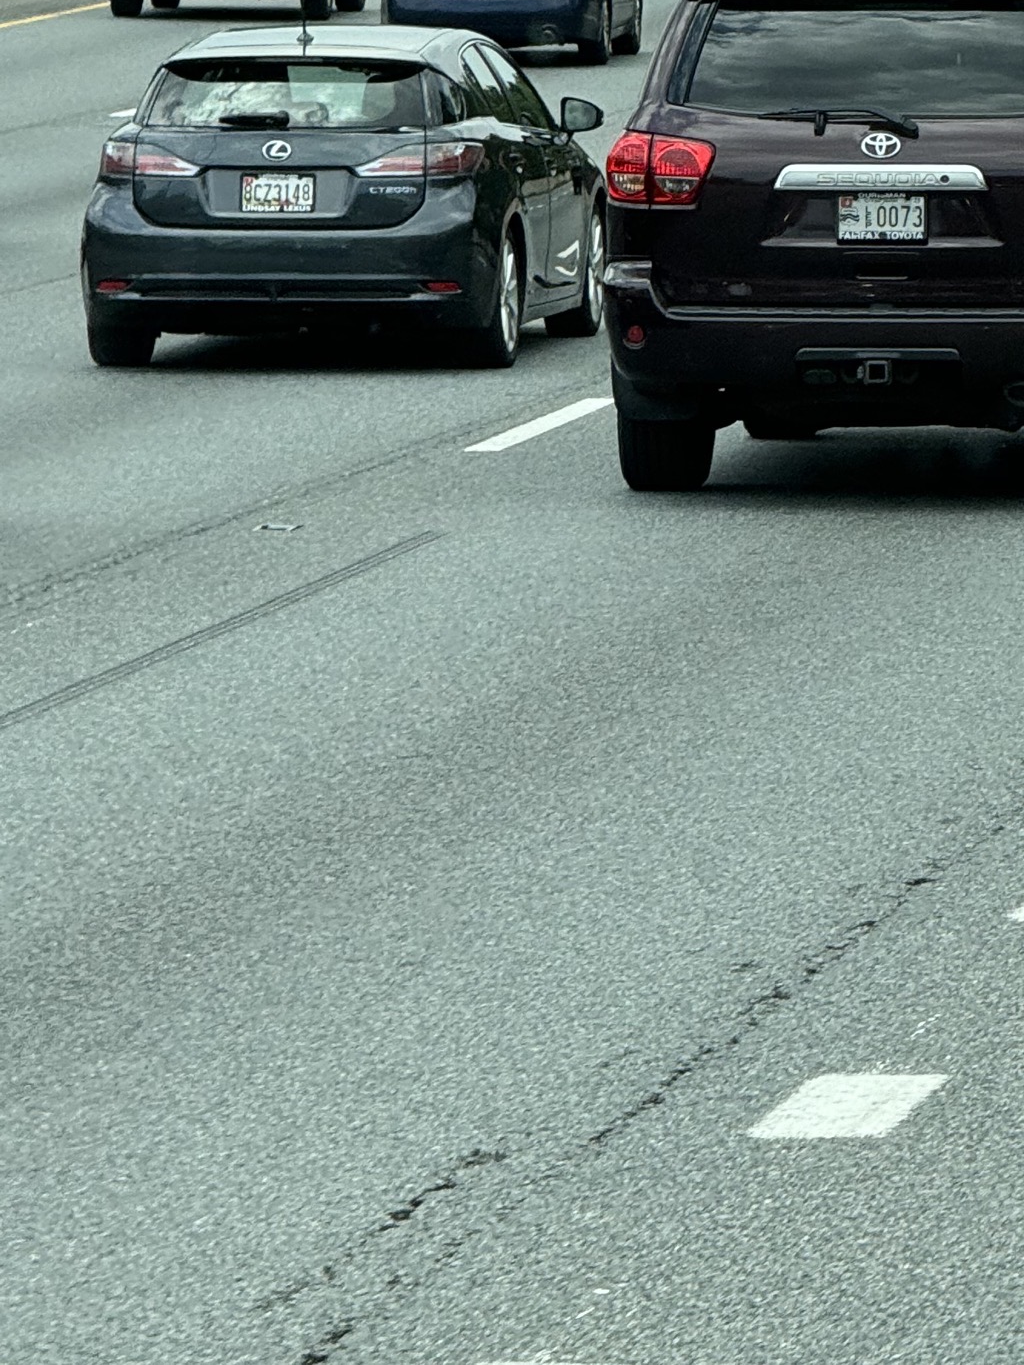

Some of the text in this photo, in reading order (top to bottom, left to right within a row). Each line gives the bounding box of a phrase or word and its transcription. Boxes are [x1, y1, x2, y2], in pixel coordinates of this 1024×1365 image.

[816, 173, 941, 187] SEQUOIA
[244, 182, 310, 203] 8CZ3148
[877, 205, 923, 227] 0073
[839, 231, 924, 240] FAIRFAX TOYOTA
